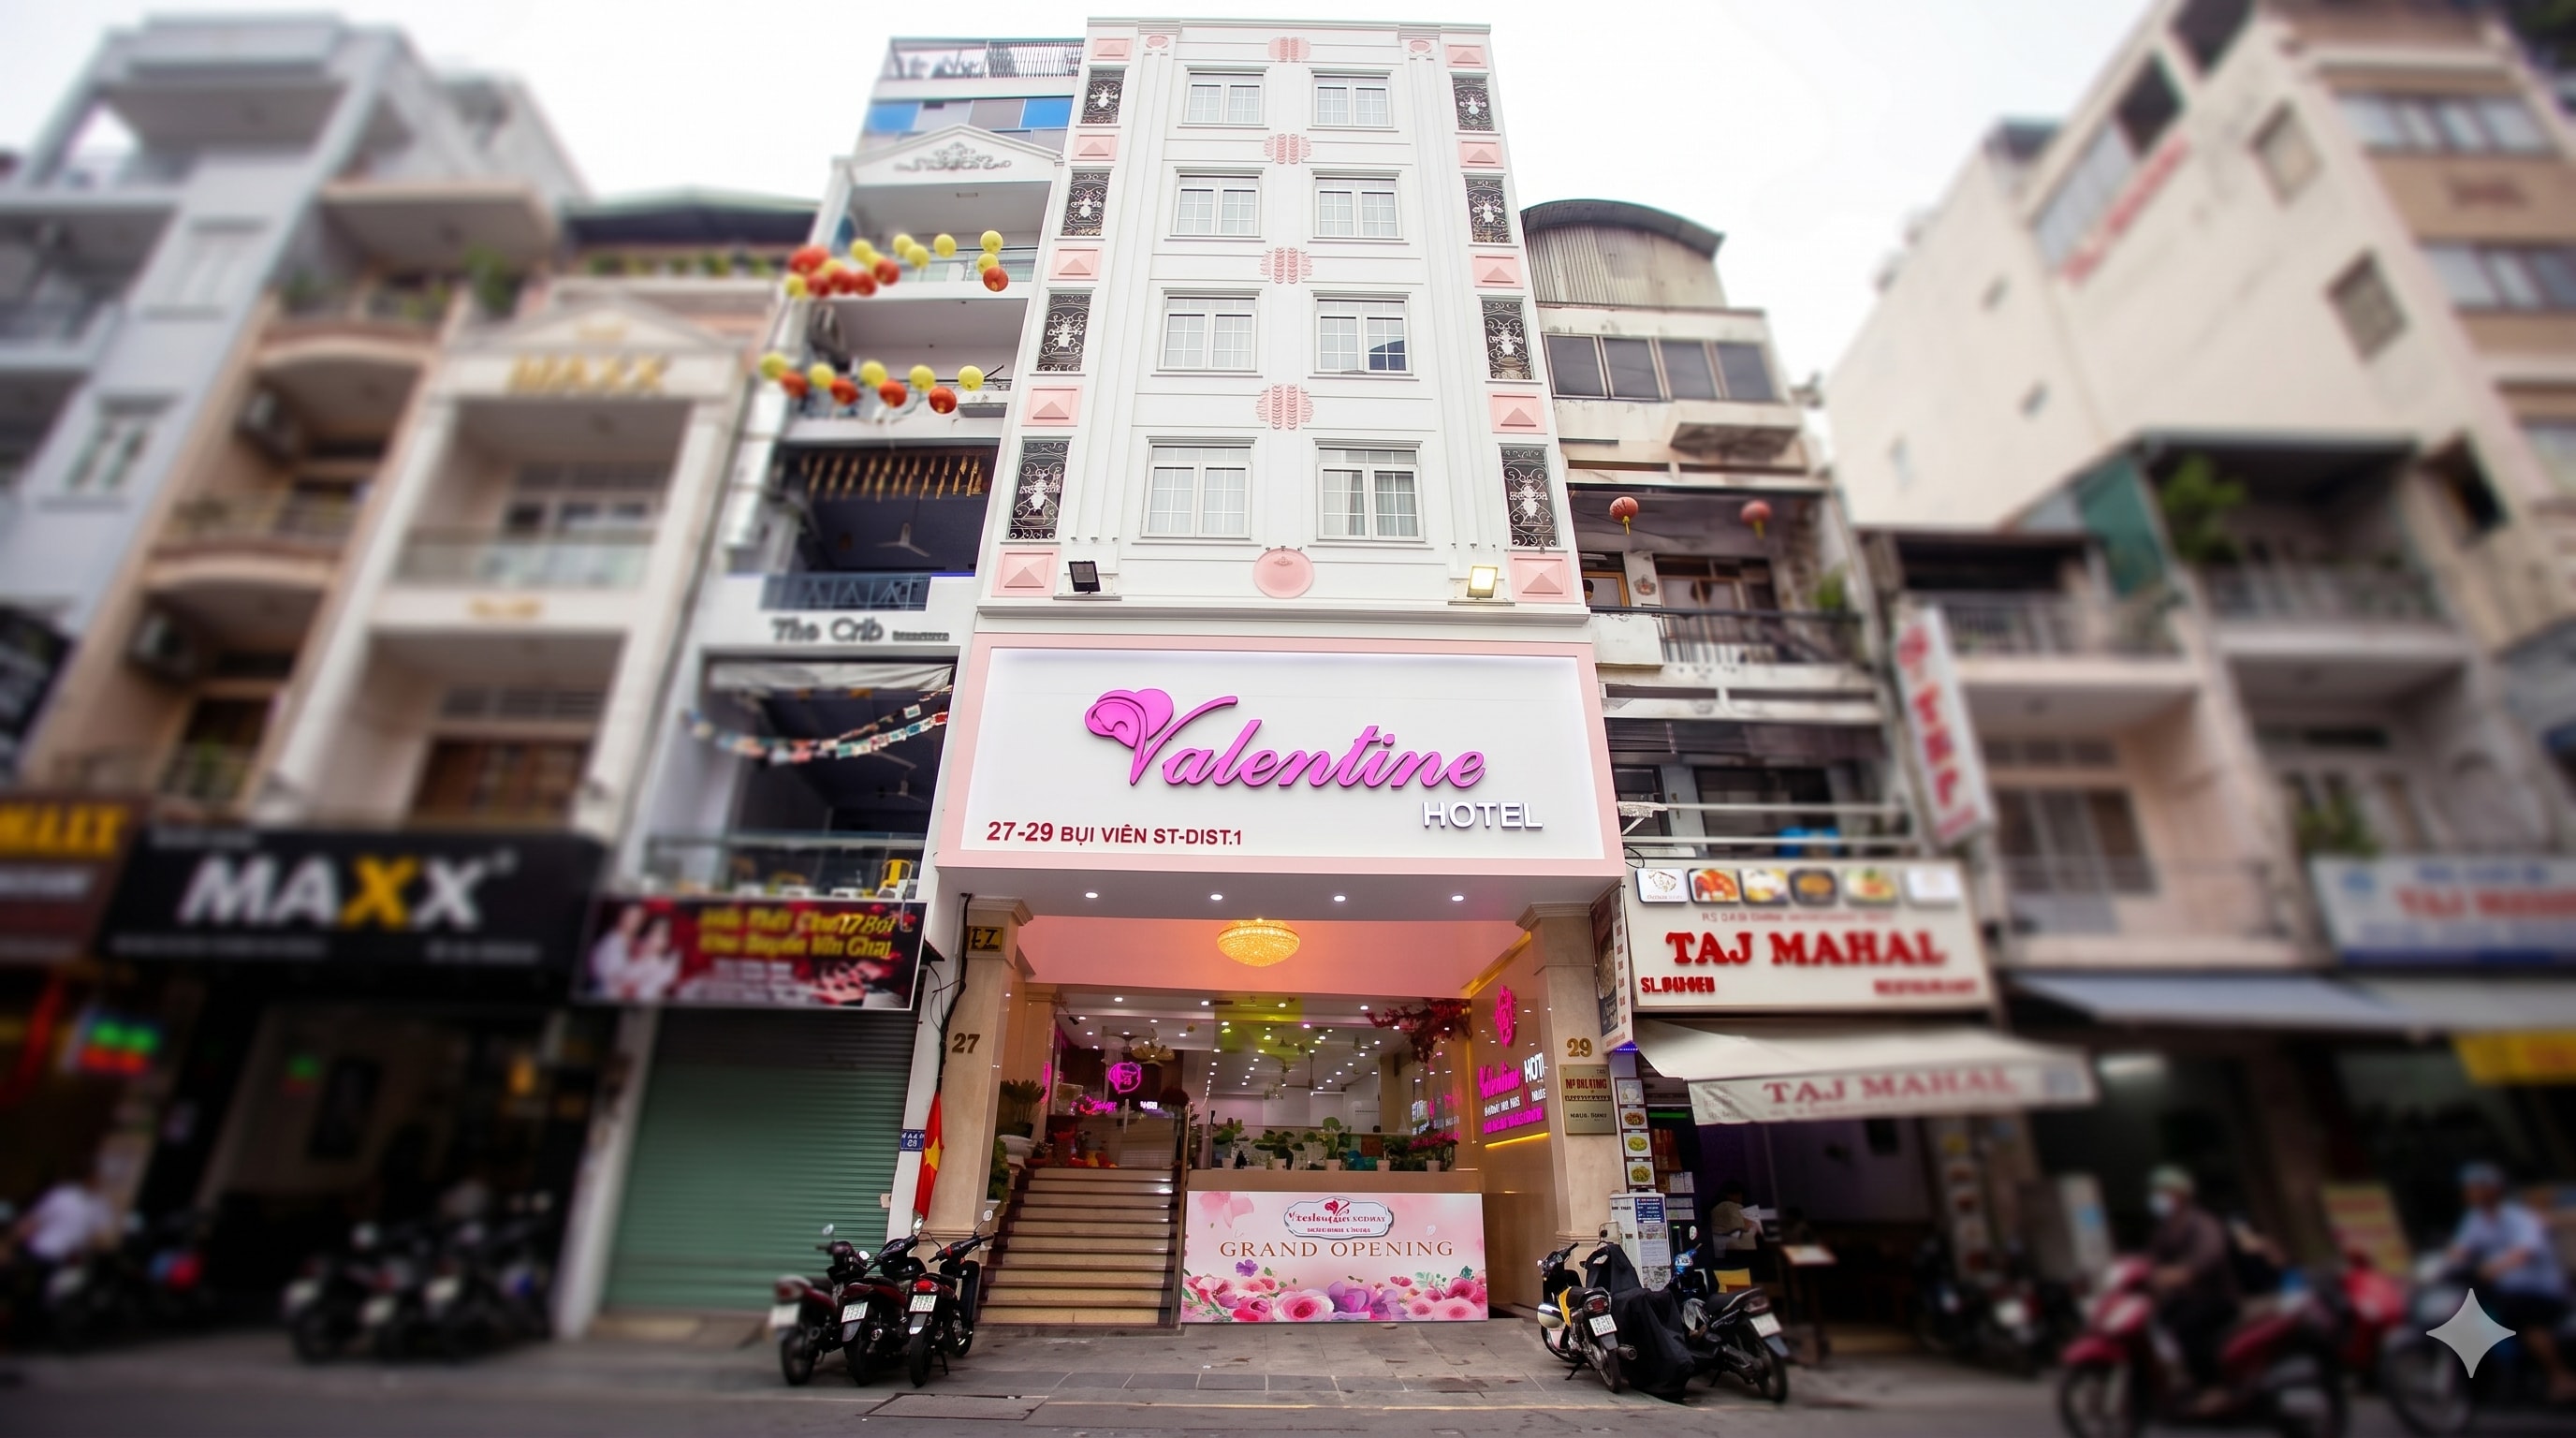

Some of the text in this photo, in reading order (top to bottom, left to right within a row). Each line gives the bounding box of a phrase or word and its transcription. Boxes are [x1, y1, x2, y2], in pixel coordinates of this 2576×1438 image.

[771, 617, 821, 642] The
[1084, 688, 1487, 789] Valentine
[1421, 800, 1544, 829] HOTEL
[986, 820, 1243, 846] 27-29 BỤI VIÊN ST-DIST.1
[181, 853, 489, 928] MAXX
[1664, 931, 1948, 967] TAJ MAHAL
[951, 1032, 981, 1054] 27
[1566, 1037, 1593, 1058] 29
[1763, 1078, 1848, 1104] TAJ
[1859, 1065, 2020, 1101] MAHAL
[1220, 1240, 1454, 1258] GRAND OPENING
